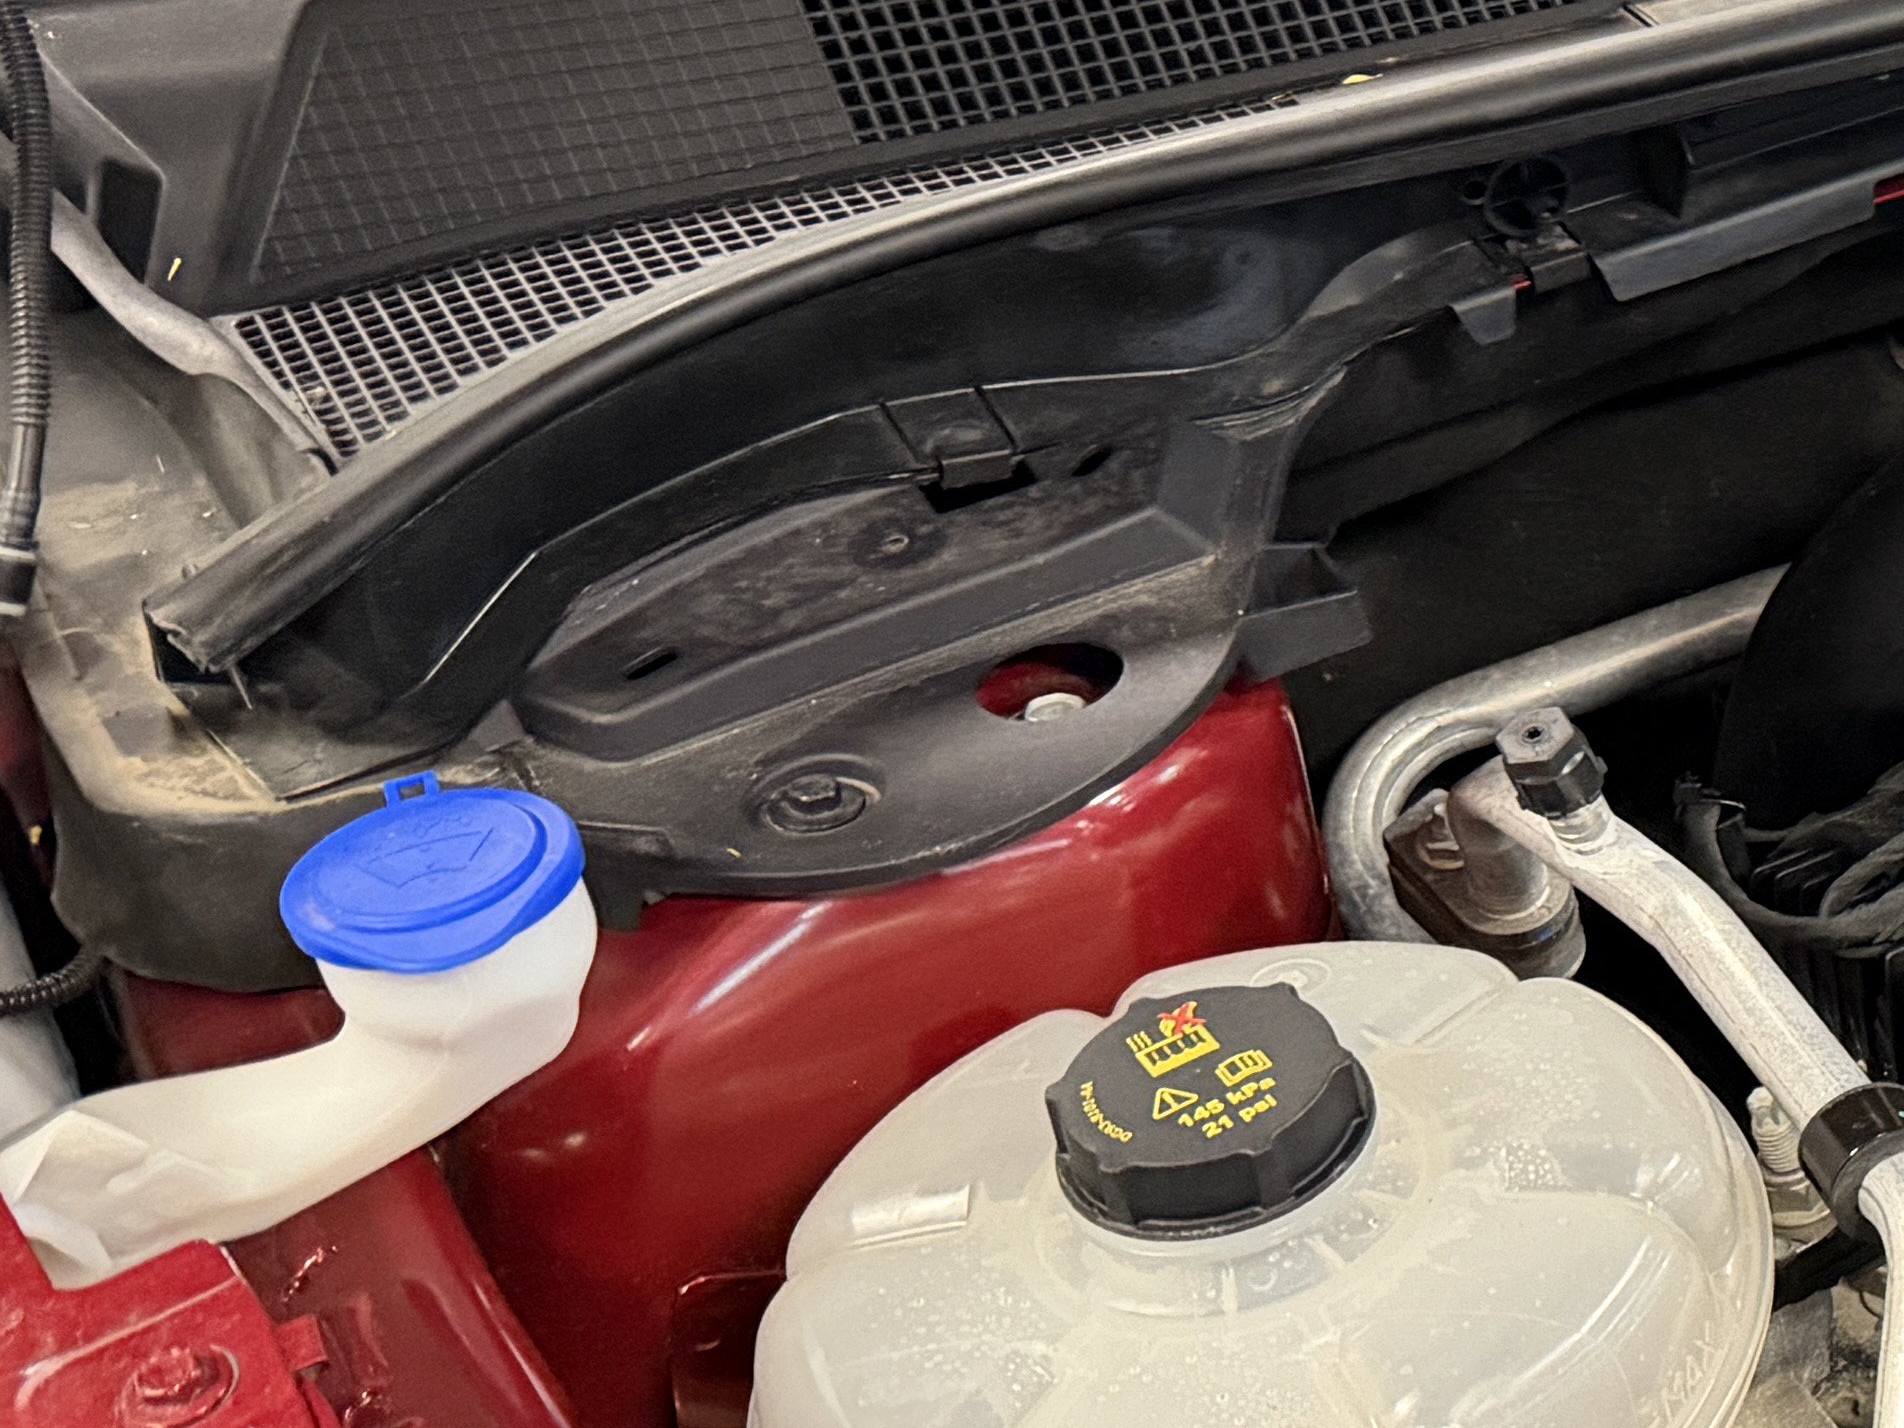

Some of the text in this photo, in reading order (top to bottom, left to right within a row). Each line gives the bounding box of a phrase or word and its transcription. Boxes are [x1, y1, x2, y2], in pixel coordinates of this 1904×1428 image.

[1178, 1077, 1276, 1127] 145 kPa
[1202, 1094, 1278, 1139] 21 psi
